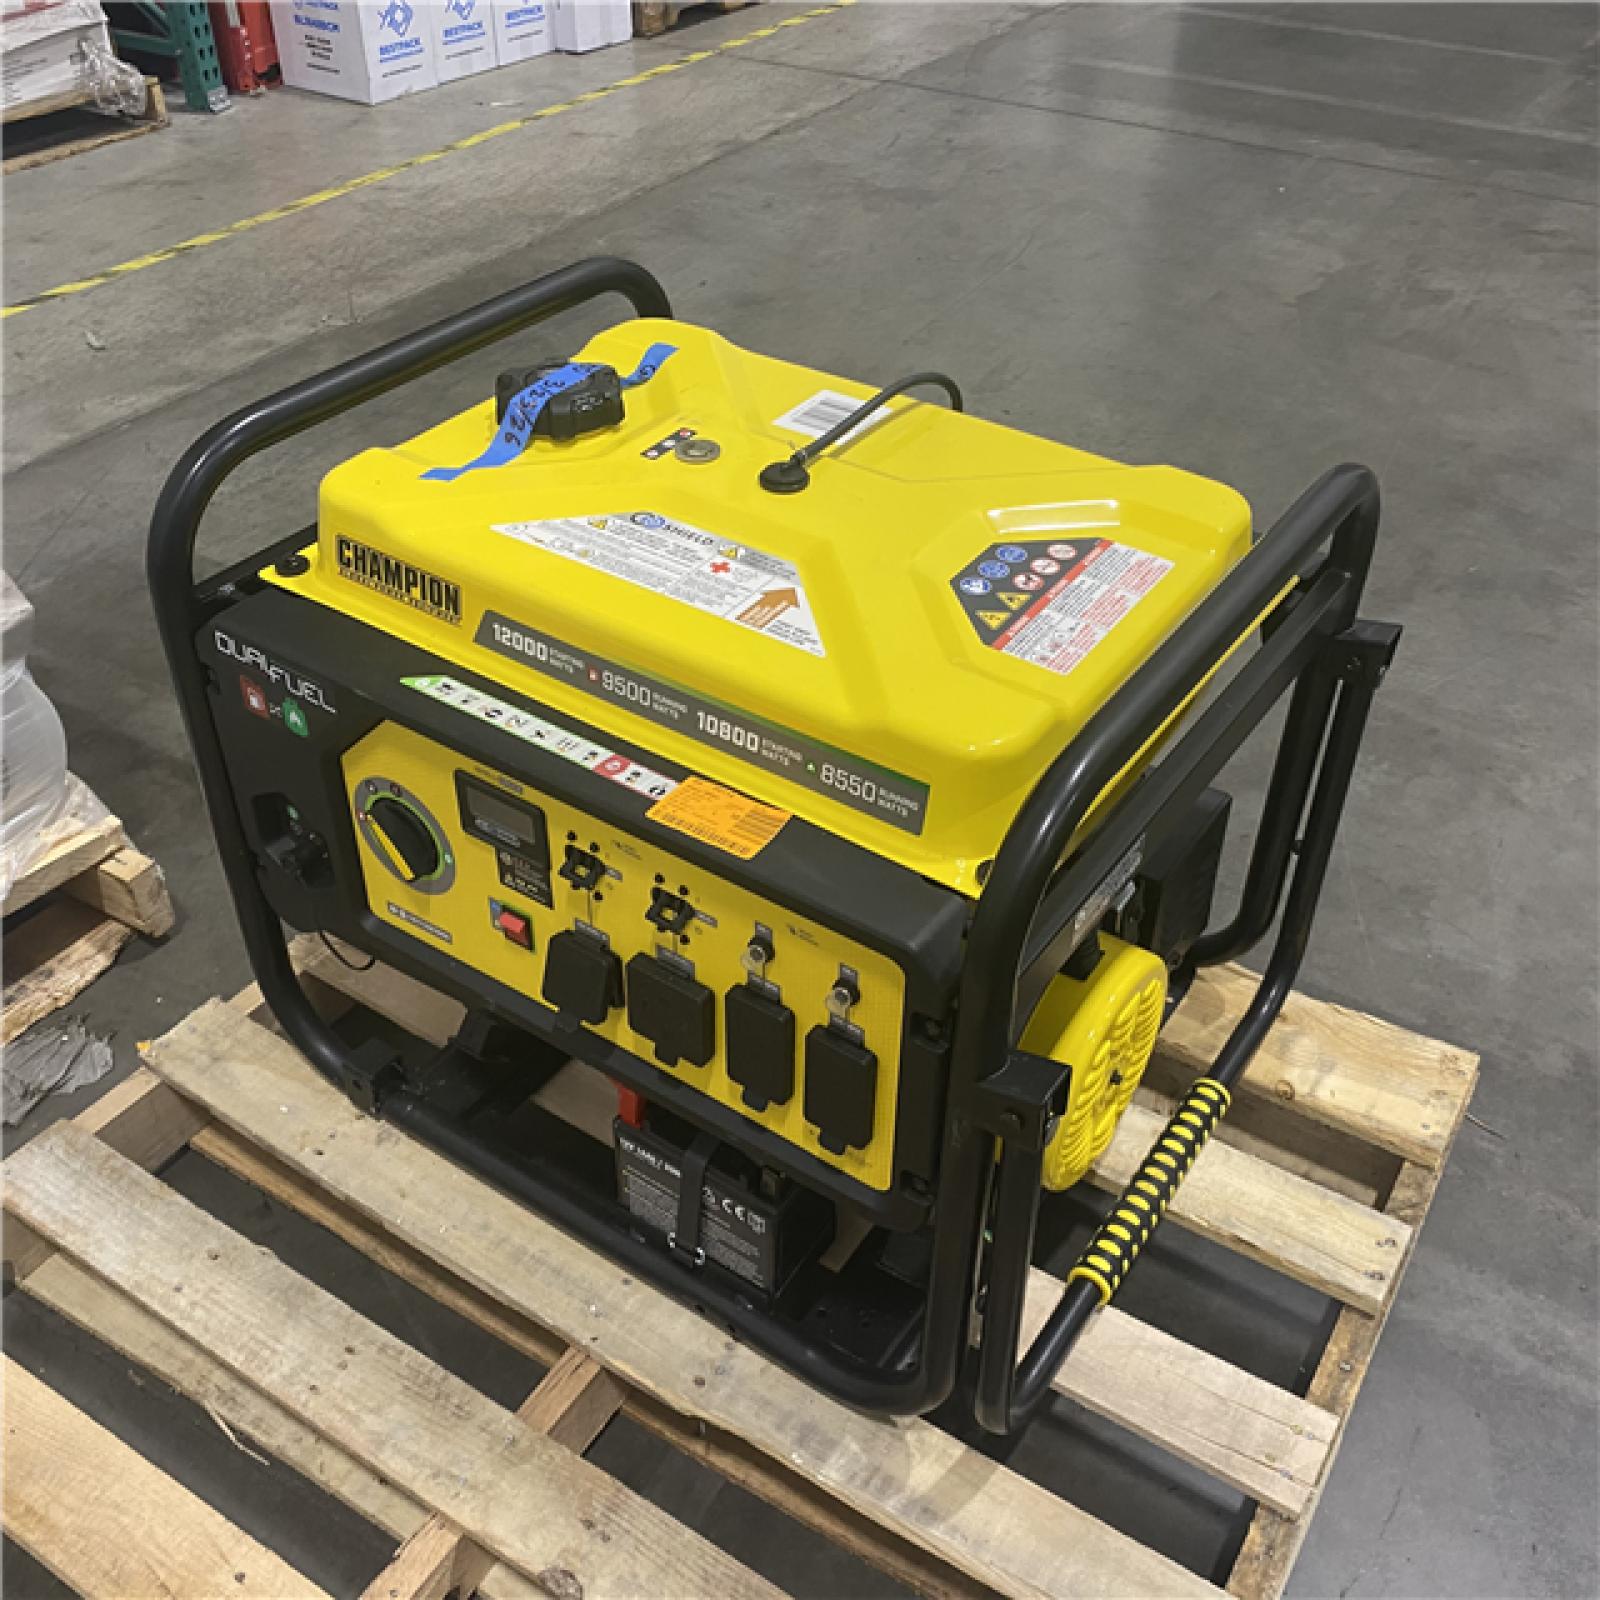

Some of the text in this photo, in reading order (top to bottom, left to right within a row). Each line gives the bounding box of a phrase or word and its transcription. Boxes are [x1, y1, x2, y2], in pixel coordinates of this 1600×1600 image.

[336, 536, 460, 616] CHAMPION
[492, 622, 549, 661] 12000
[696, 710, 760, 753] 10800
[819, 762, 876, 804] 8550
